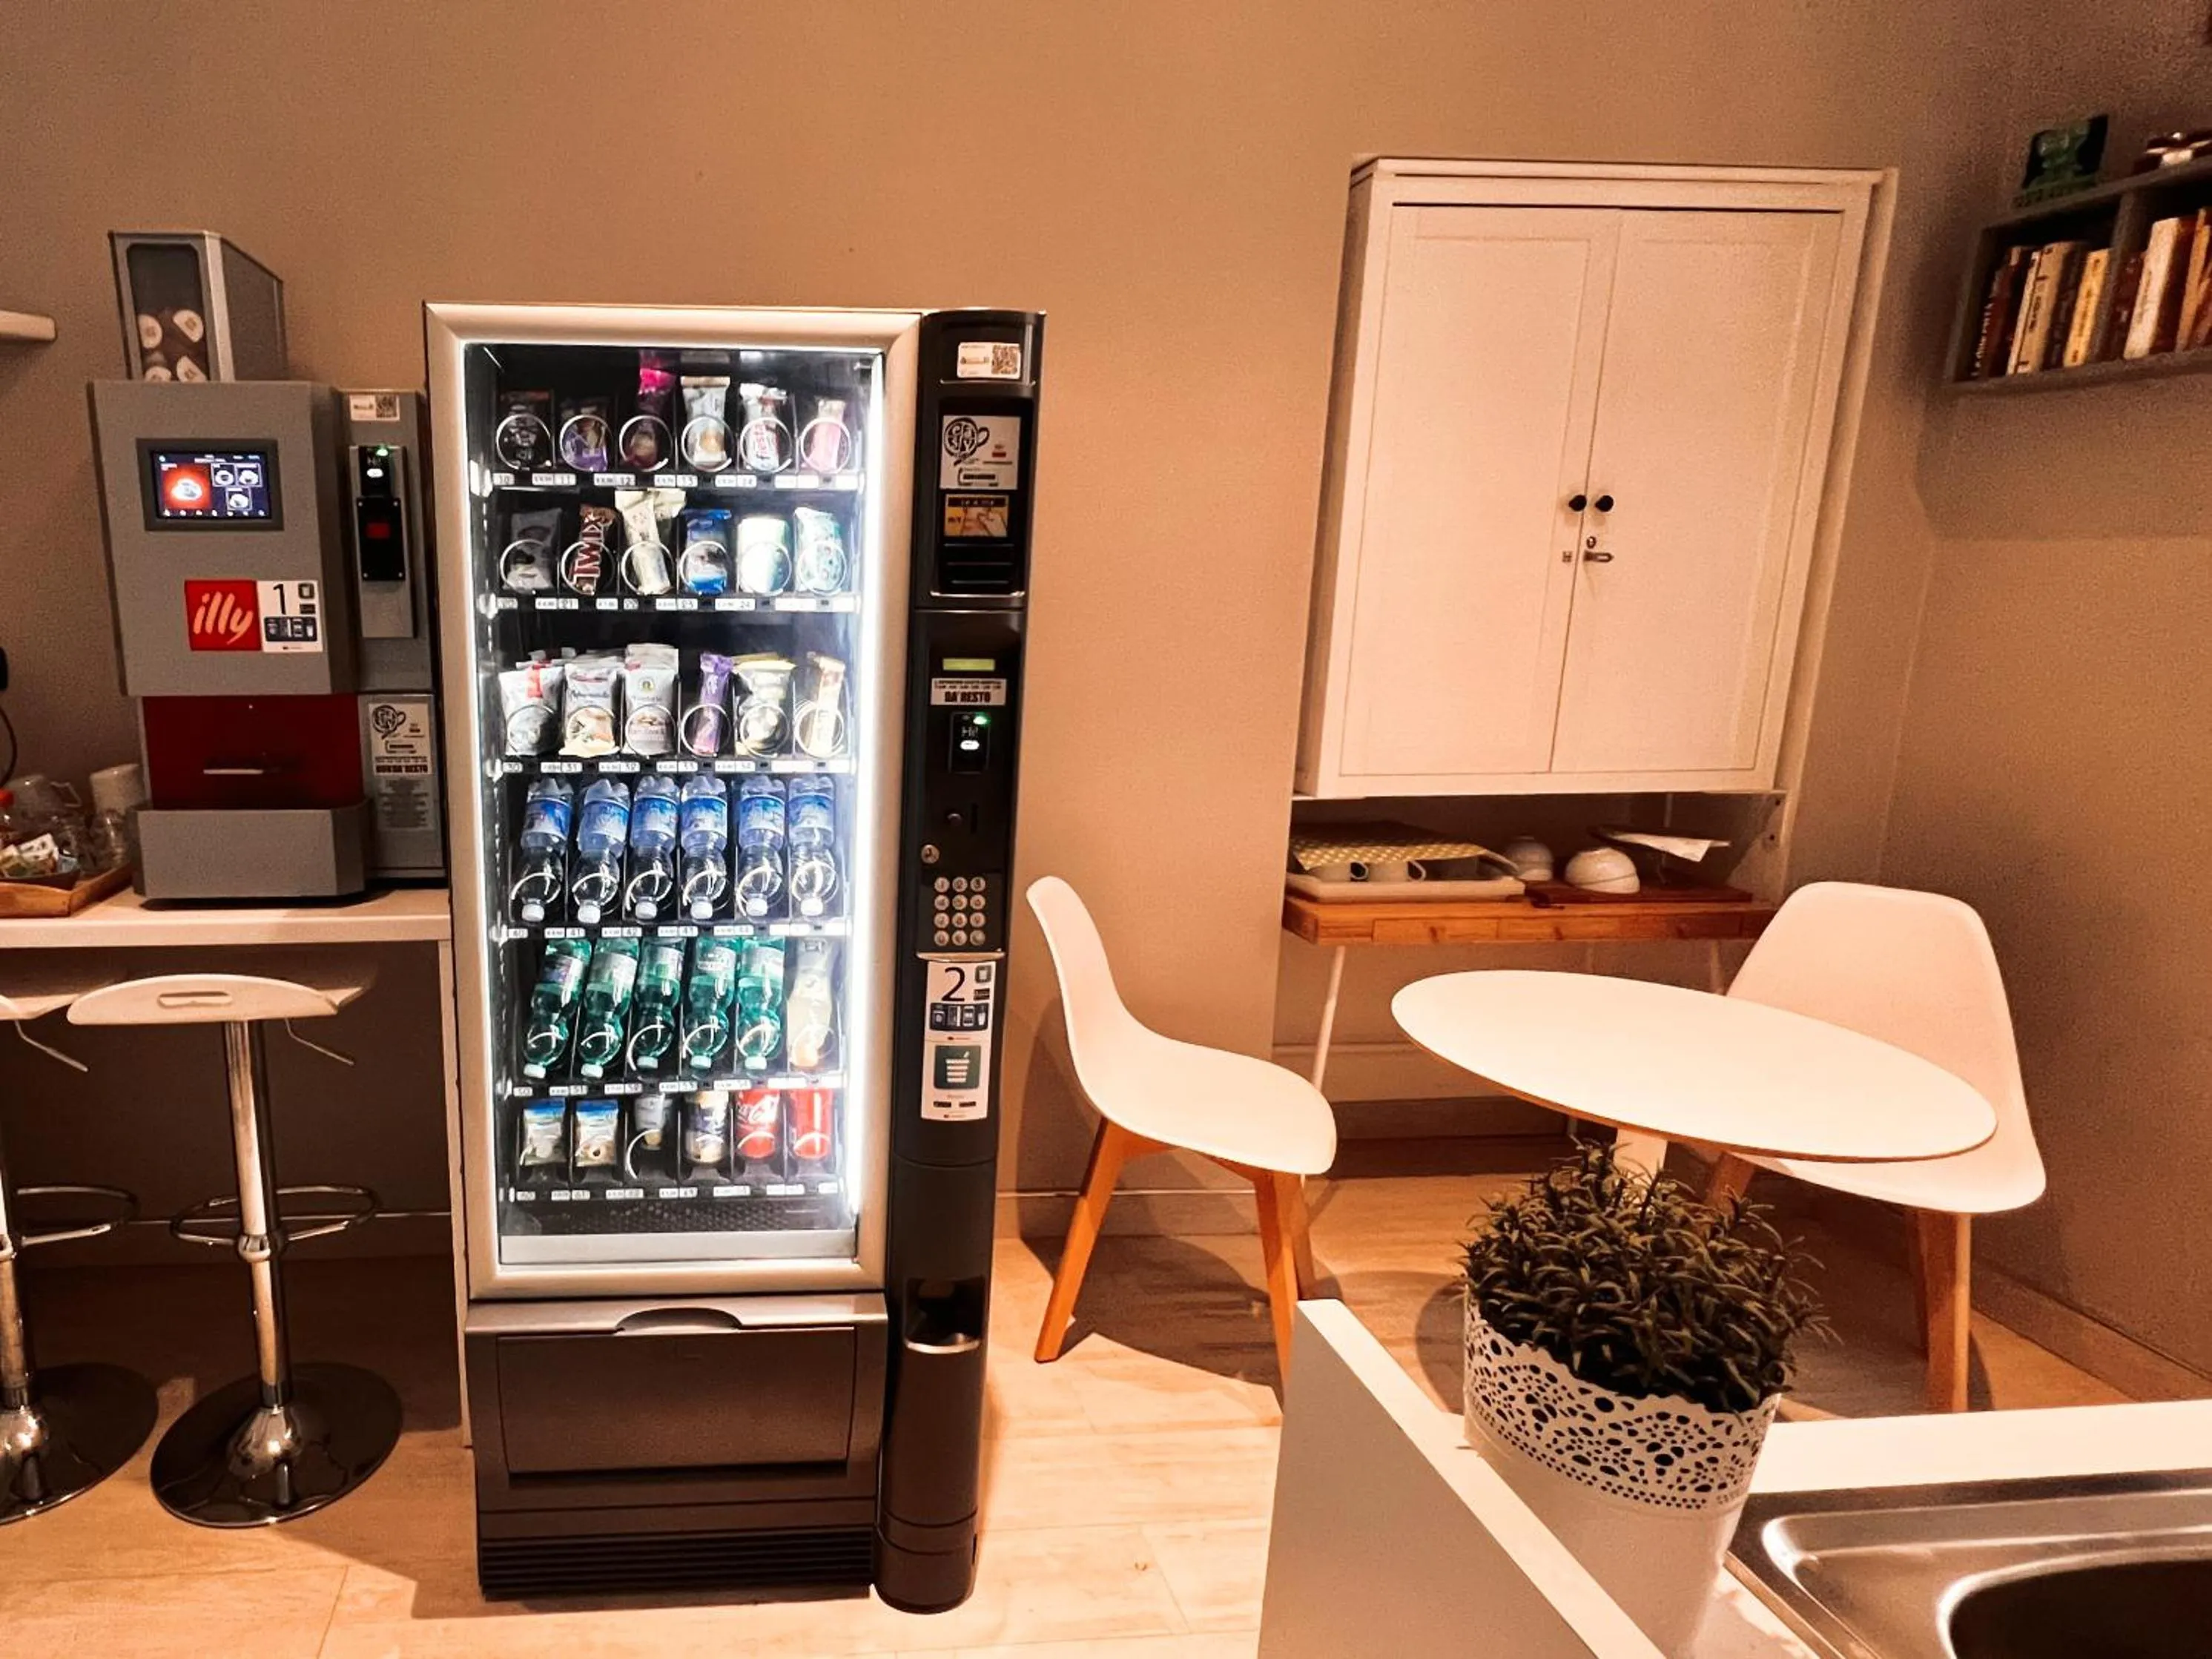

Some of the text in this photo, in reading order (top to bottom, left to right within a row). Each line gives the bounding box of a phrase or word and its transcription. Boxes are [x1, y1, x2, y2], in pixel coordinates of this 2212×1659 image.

[569, 517, 603, 585] TWIX
[193, 591, 254, 645] illy
[273, 583, 286, 615] 1
[941, 966, 965, 1001] 2
